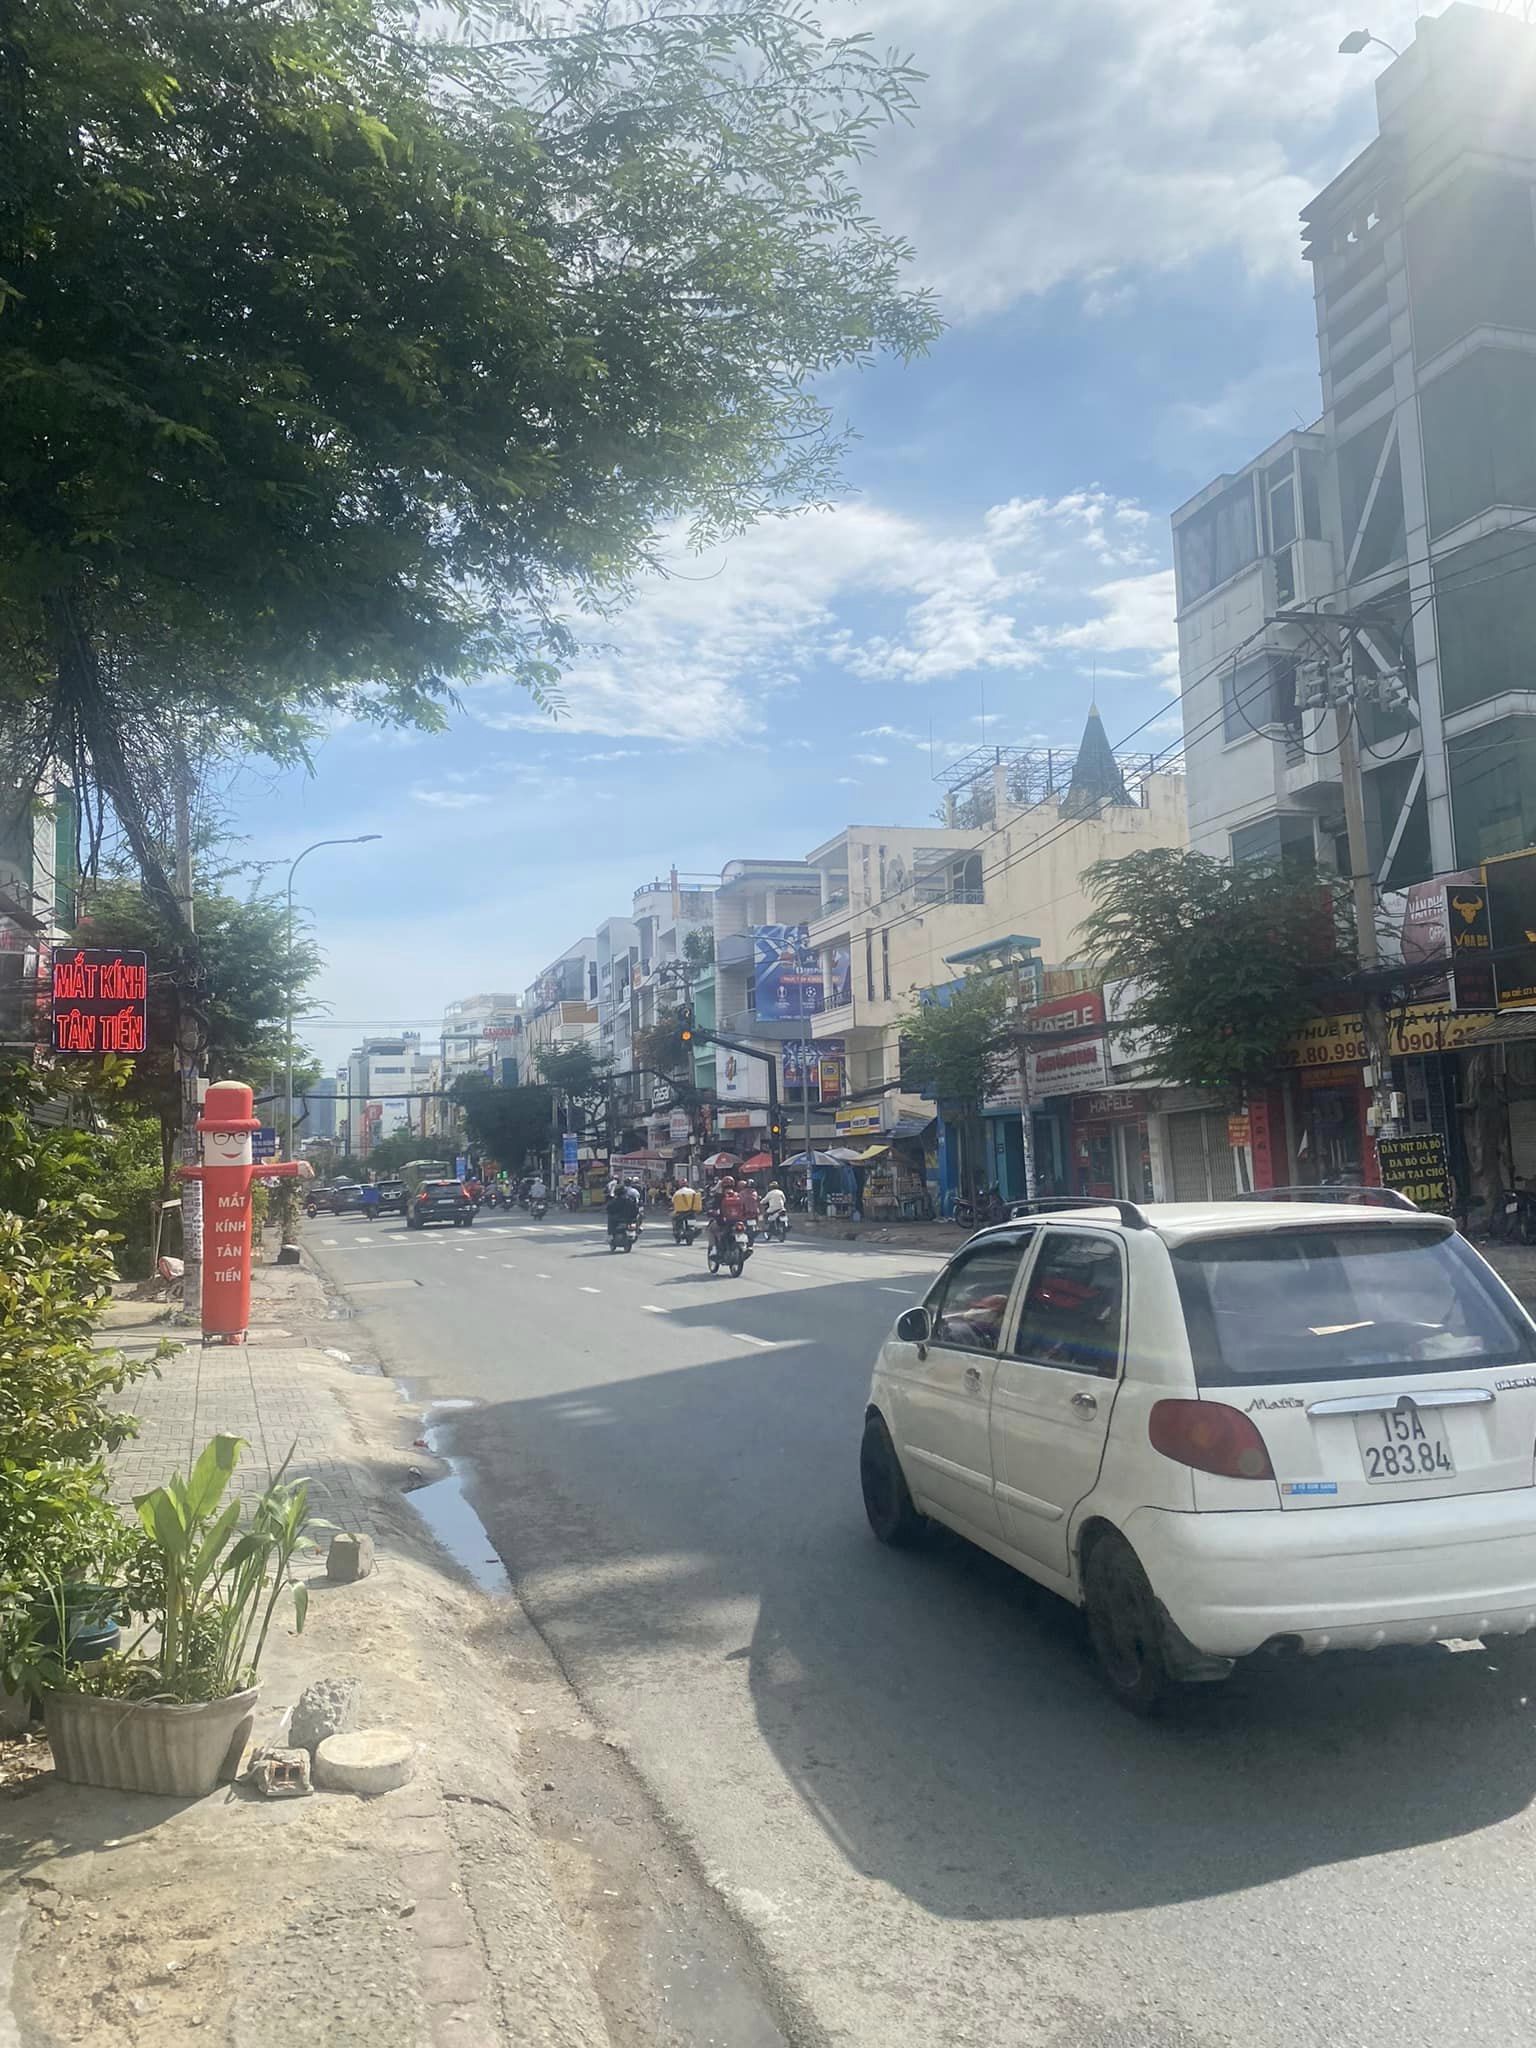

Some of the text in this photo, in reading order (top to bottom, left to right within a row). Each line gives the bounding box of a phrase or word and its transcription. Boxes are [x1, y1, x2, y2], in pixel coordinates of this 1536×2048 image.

[55, 951, 145, 999] MẮT KÍNH
[57, 1005, 143, 1050] TÂN TIẾN
[1416, 1140, 1428, 1150] DA
[1389, 1159, 1403, 1168] DA
[218, 1191, 246, 1208] MẮT
[215, 1218, 247, 1233] KÍNH
[216, 1243, 242, 1257] TÂN
[214, 1266, 241, 1282] TIẾN
[1380, 1409, 1426, 1442] 15A
[1366, 1441, 1451, 1478] 283.84
